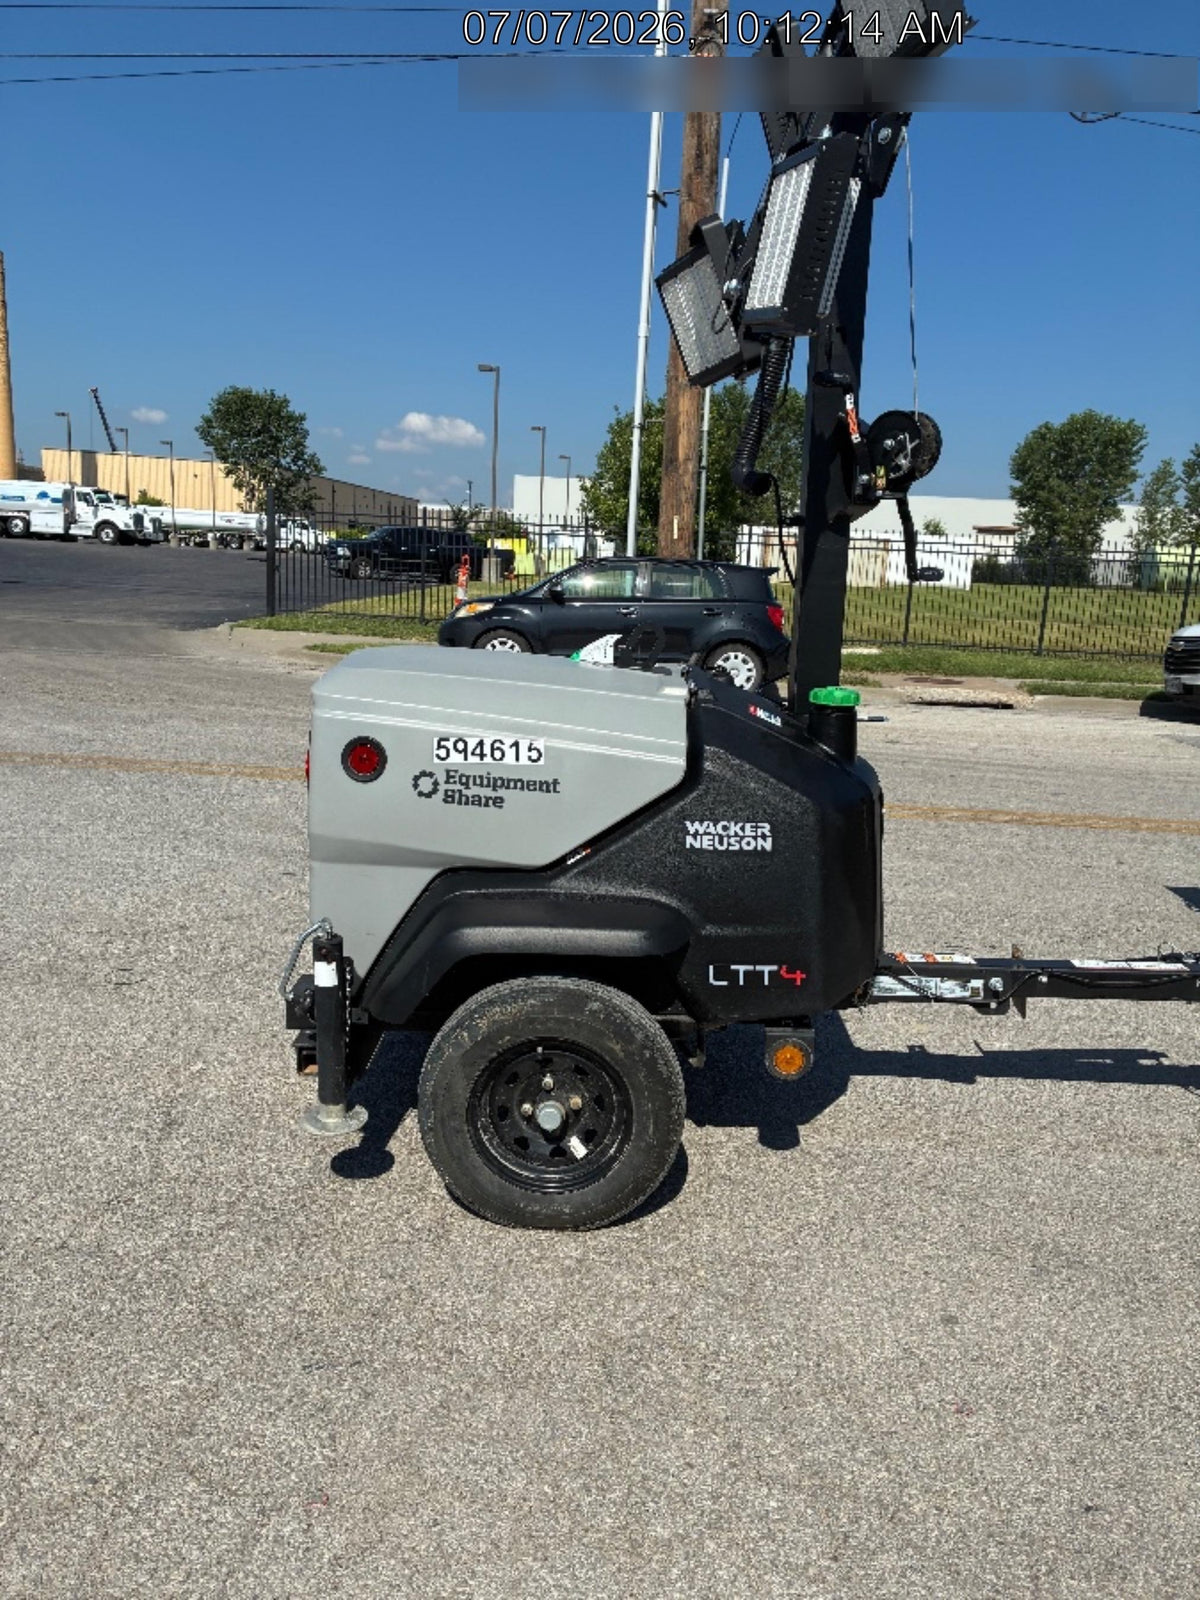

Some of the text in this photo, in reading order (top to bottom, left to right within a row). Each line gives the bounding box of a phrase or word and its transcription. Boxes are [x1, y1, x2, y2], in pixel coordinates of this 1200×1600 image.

[434, 737, 543, 763] 594615
[444, 768, 561, 794] Equipment
[442, 788, 505, 809] Share
[684, 820, 772, 837] WACKER
[685, 835, 773, 852] NEUSON
[708, 964, 807, 986] LTT4
